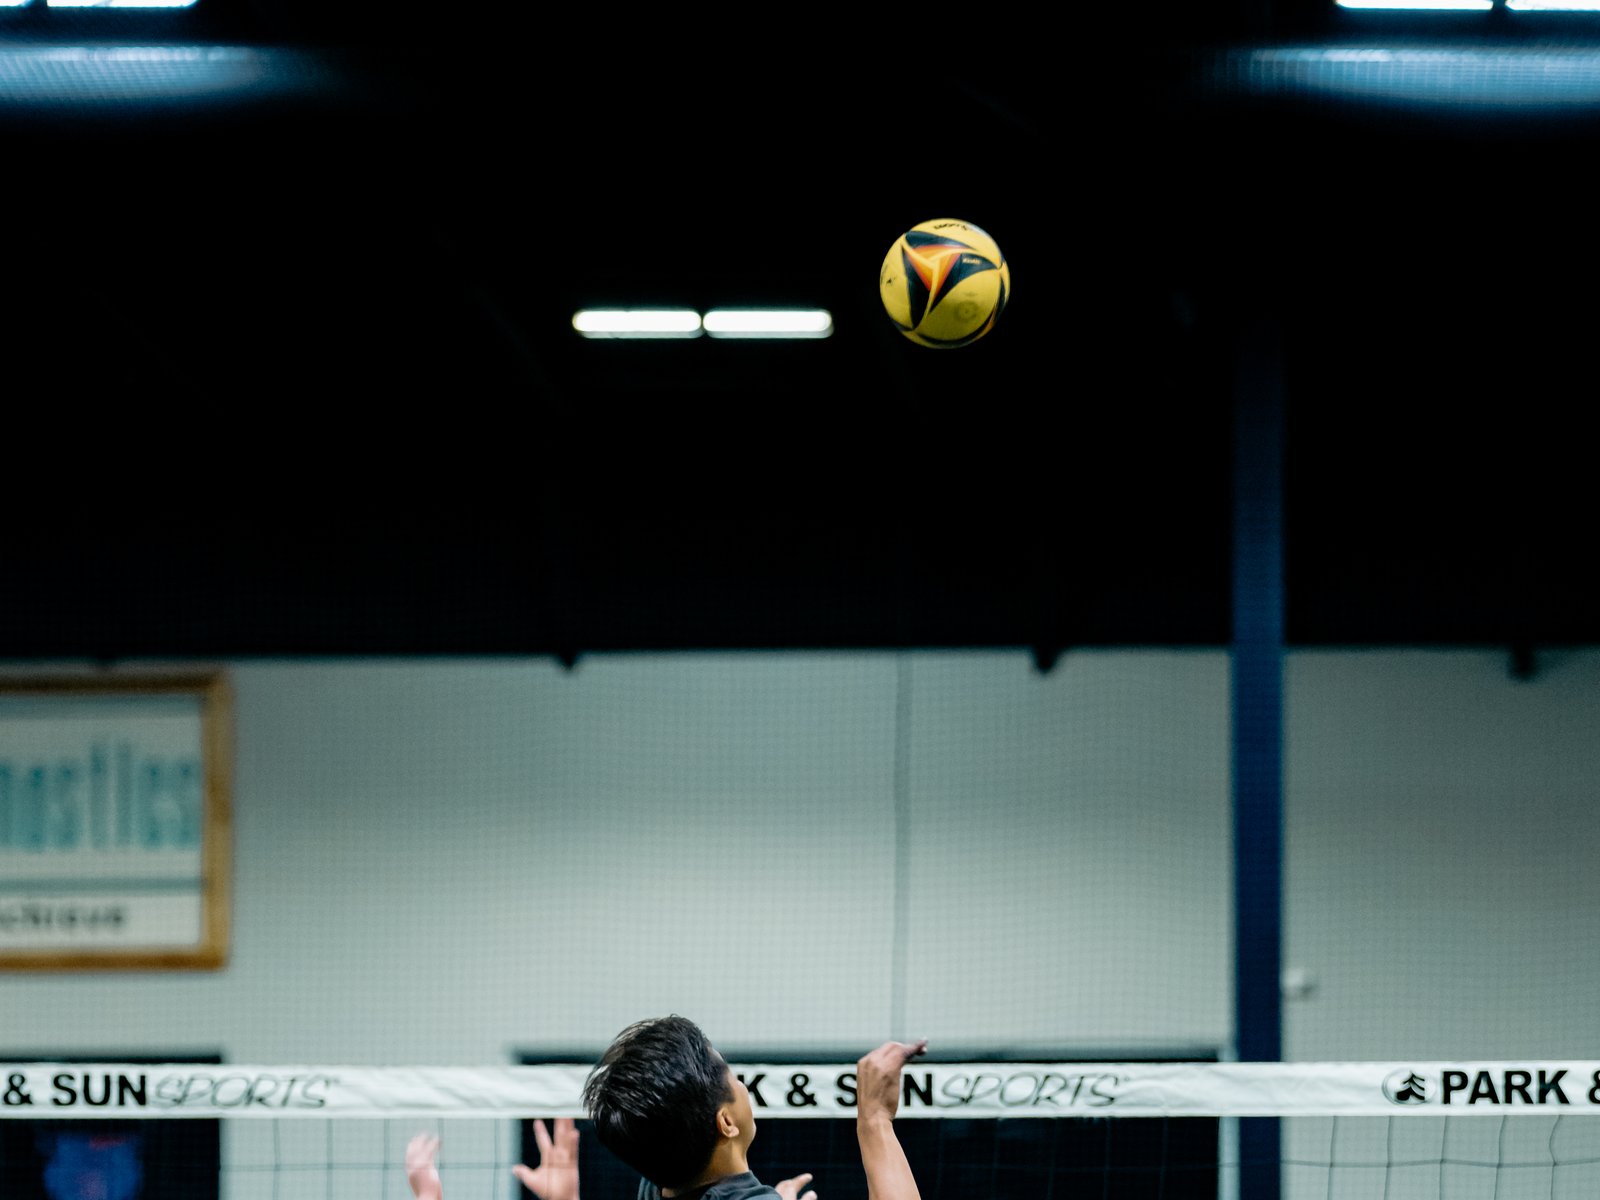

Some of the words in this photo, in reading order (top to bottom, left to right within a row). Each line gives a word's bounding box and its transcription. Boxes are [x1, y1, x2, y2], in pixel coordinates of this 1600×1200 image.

[3, 1072, 32, 1106] &
[51, 1073, 146, 1106] SUN
[155, 1074, 331, 1108] SPORTS
[786, 1073, 818, 1107] &
[836, 1073, 932, 1107] SN
[941, 1072, 1120, 1106] SPORTS
[1441, 1069, 1571, 1105] PARK
